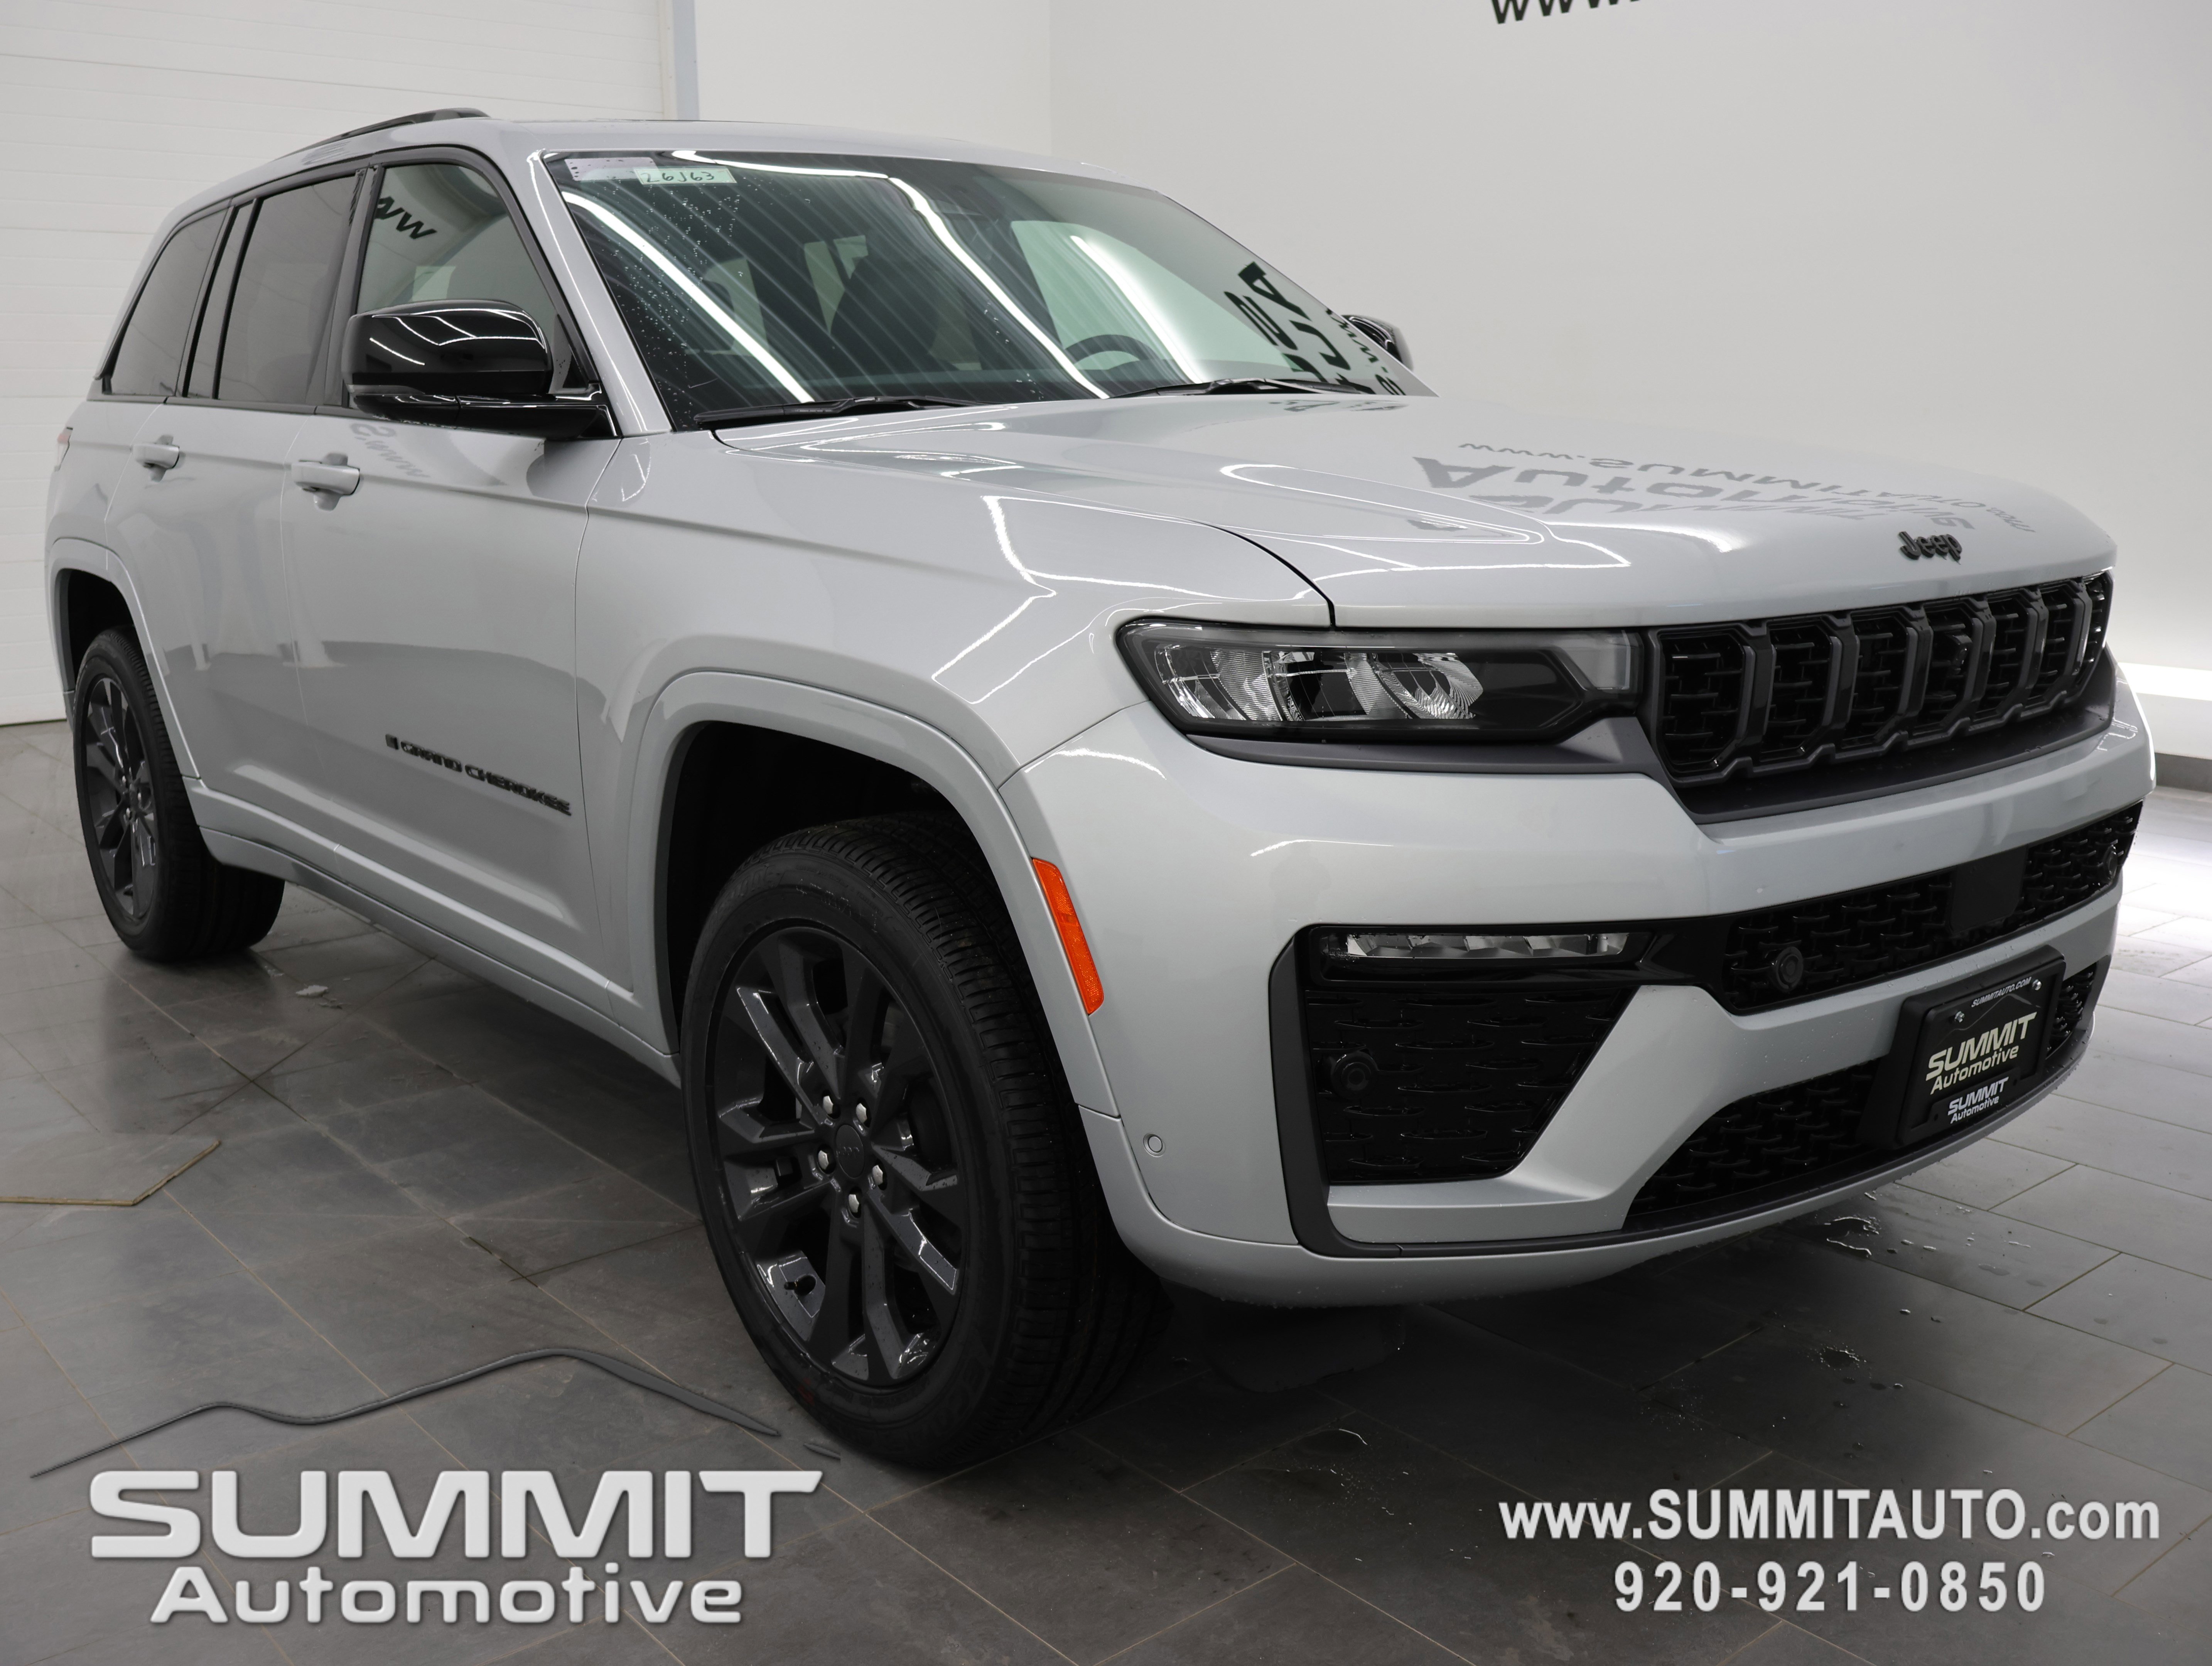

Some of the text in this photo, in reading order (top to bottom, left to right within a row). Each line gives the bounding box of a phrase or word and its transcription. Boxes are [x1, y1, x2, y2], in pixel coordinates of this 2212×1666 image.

[641, 172, 715, 183] 26J63
[1898, 531, 1962, 561] Jeep
[1971, 976, 2032, 1008] SUMMITAUTO.COM
[1925, 1011, 2037, 1081] SUMMIT
[1930, 1045, 2019, 1095] Automotive
[1947, 1076, 2009, 1116] SUMMIT
[1950, 1096, 1999, 1124] Automotive
